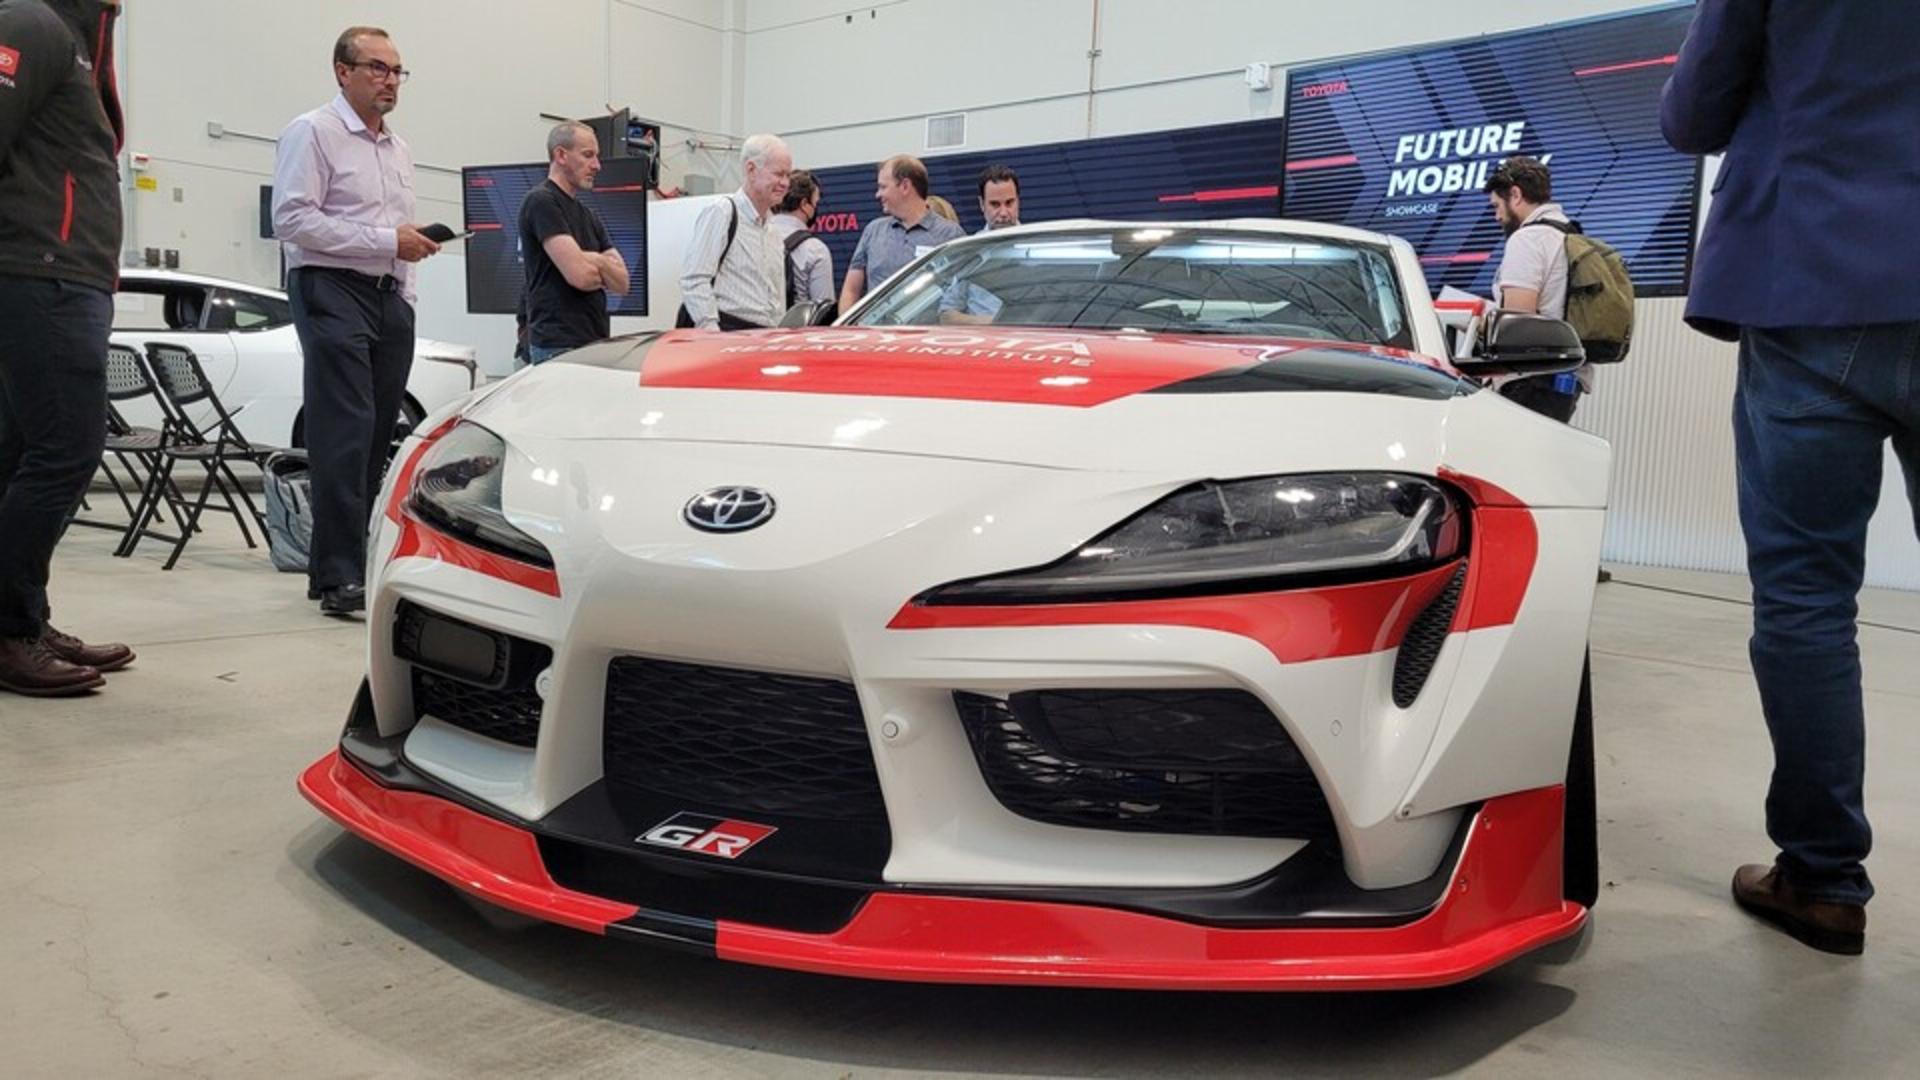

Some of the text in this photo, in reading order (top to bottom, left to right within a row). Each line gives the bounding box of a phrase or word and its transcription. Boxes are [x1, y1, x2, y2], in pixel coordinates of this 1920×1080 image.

[1303, 82, 1346, 97] TOYOTA
[1394, 121, 1525, 163] FUTURE
[1386, 153, 1552, 198] MOBIL
[1384, 203, 1439, 217] SHOWCASE
[719, 344, 1095, 367] RESEARCH INSTITUTE
[765, 331, 1092, 357] TOYOTA
[645, 824, 751, 857] GR
